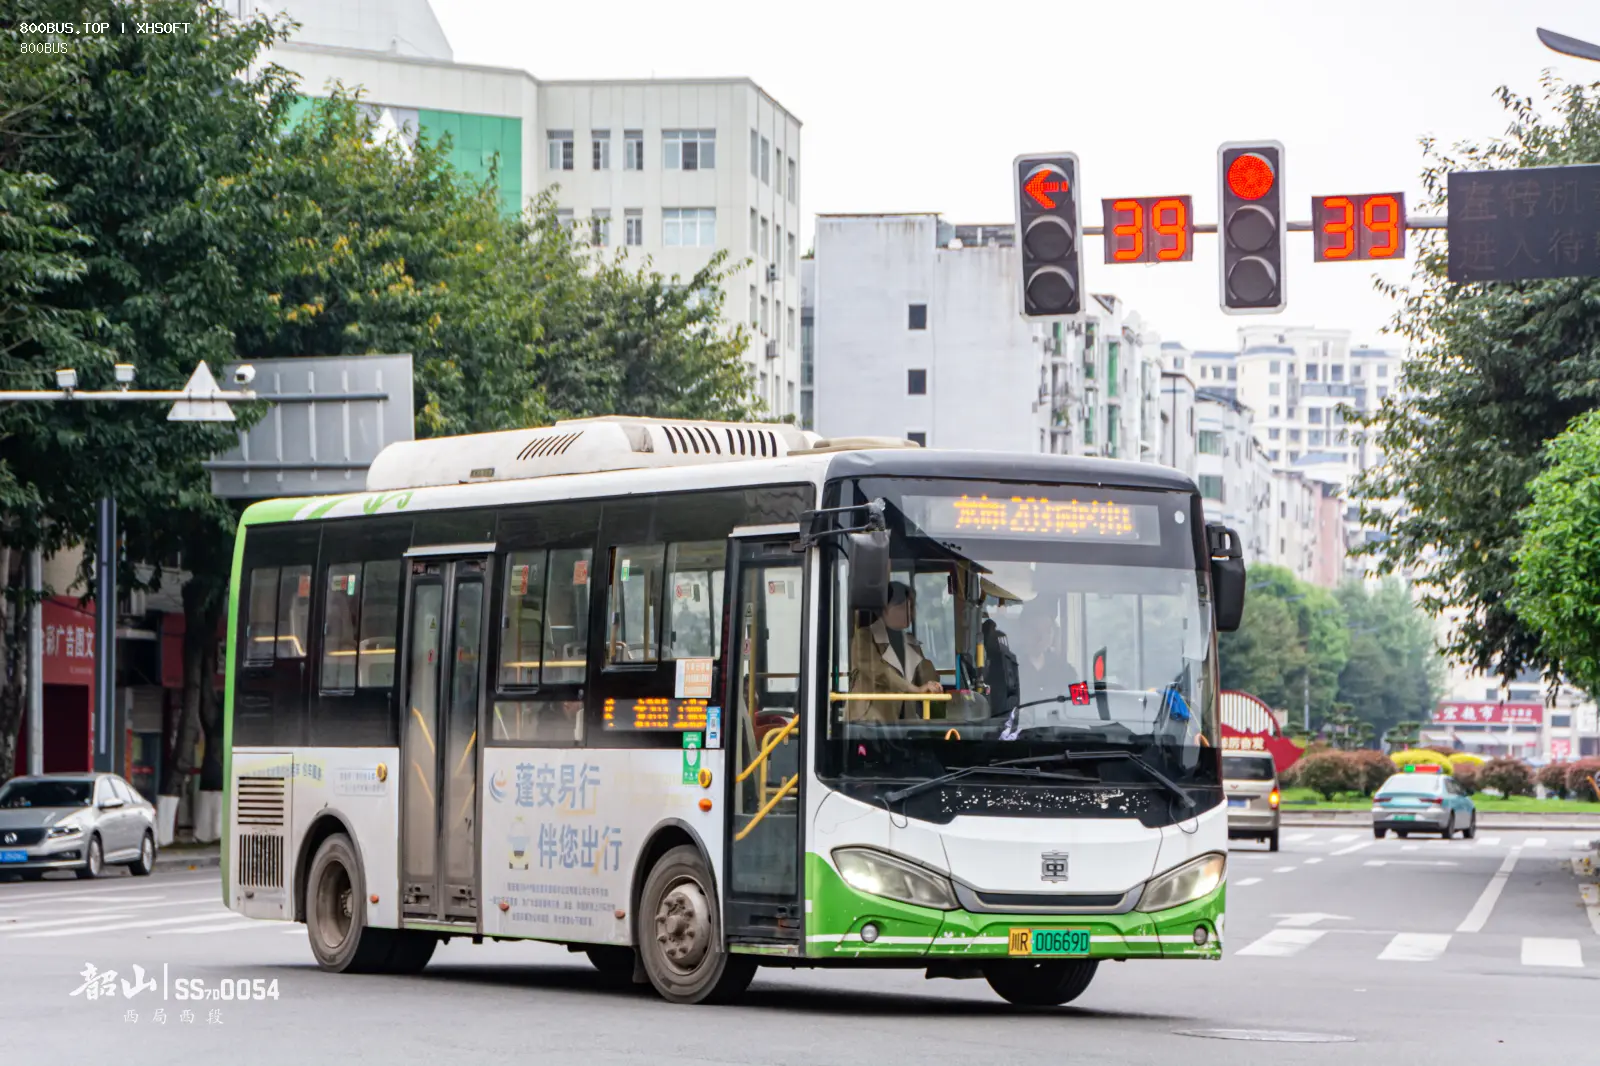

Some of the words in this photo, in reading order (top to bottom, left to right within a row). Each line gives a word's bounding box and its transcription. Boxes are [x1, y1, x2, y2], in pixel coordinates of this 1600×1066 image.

[1113, 199, 1188, 261] 39
[1323, 195, 1399, 258] 39
[1457, 227, 1600, 271] 进入待
[42, 624, 95, 660] 彩广告图文
[515, 762, 601, 814] 蓬安易行
[538, 822, 623, 872] 伴您出行
[1035, 932, 1089, 952] 00669D
